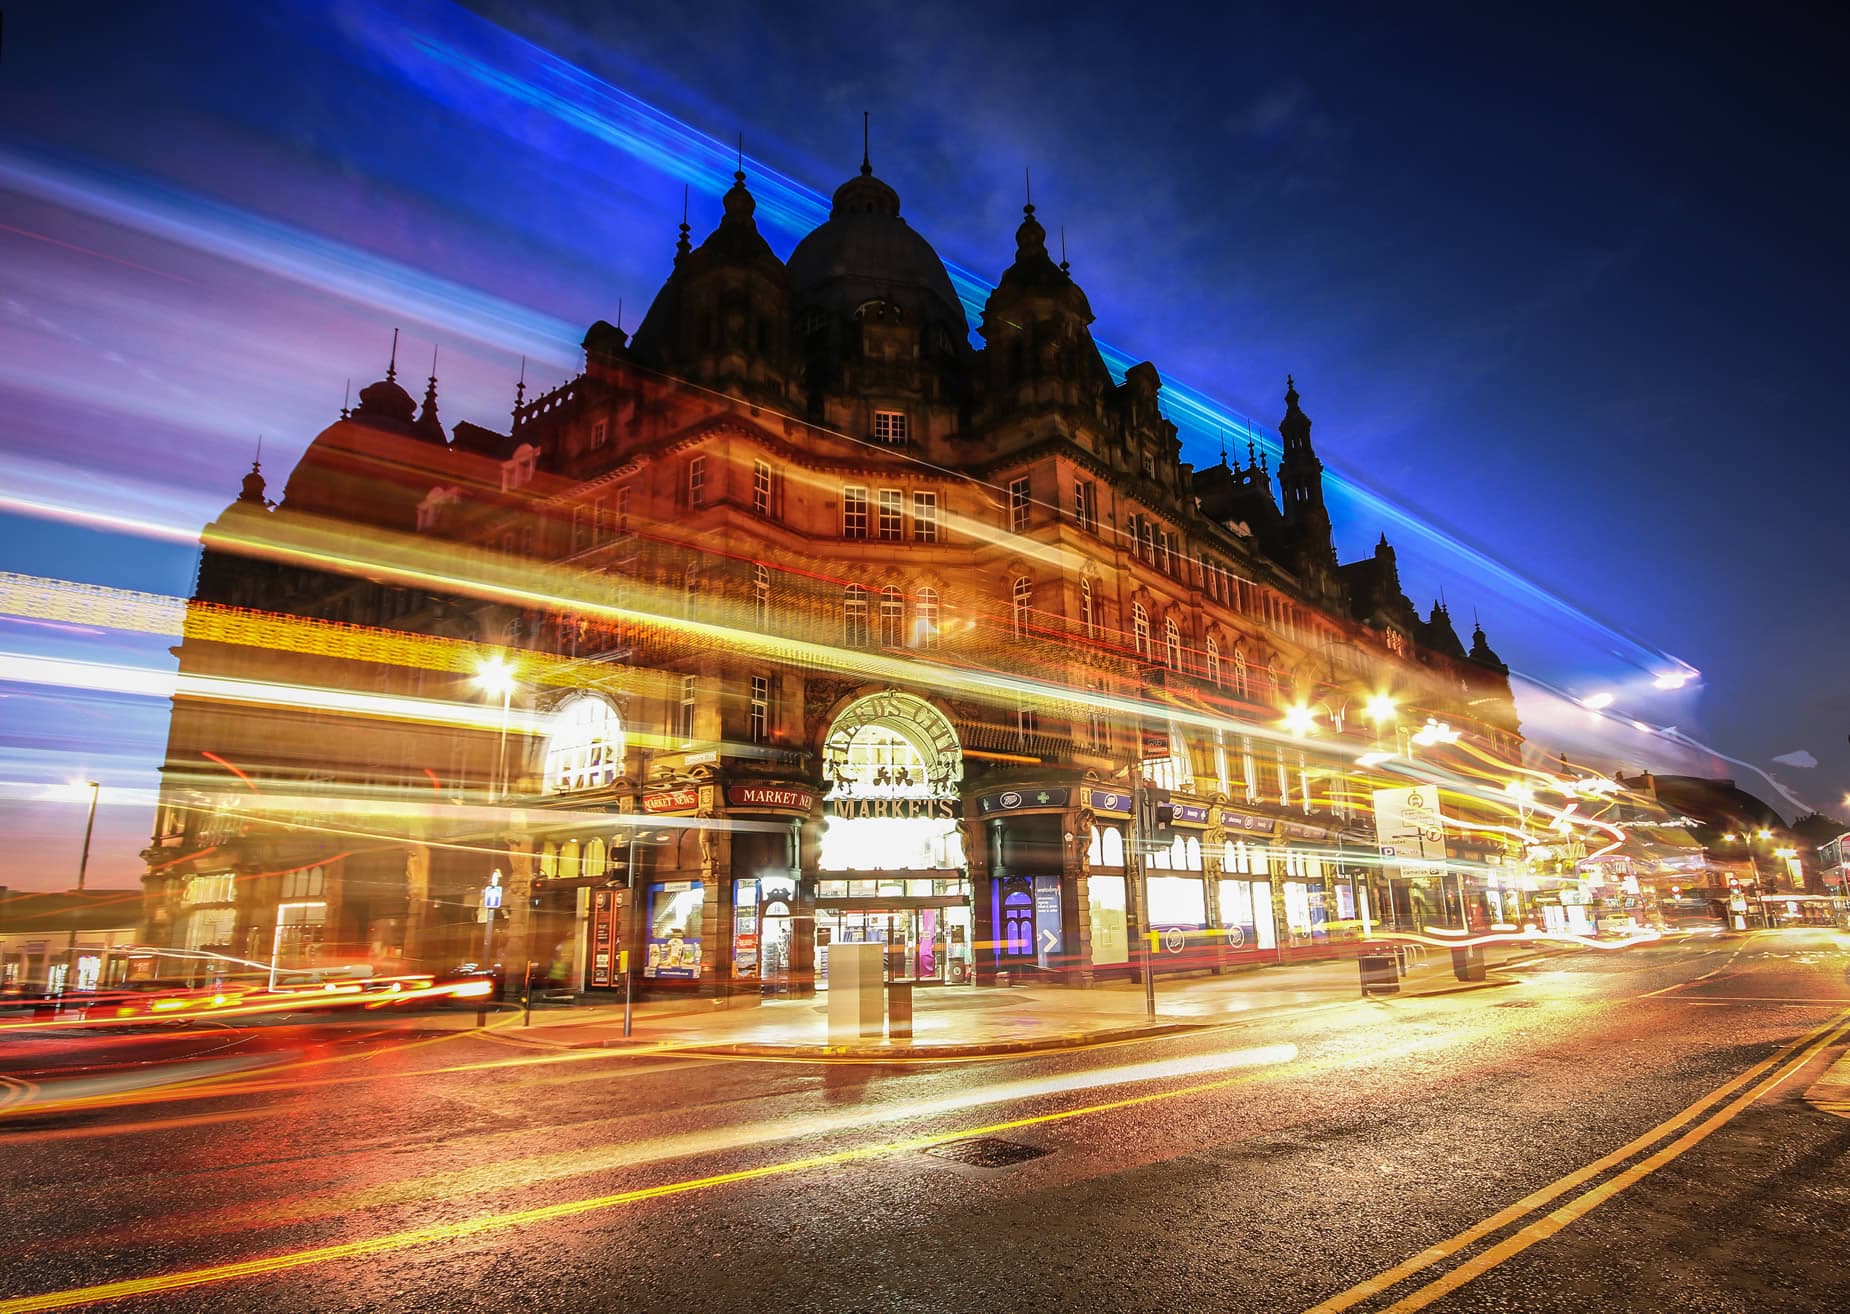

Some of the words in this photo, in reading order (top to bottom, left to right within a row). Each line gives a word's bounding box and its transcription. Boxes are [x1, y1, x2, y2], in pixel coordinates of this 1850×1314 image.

[827, 699, 902, 754] LEEDS
[912, 705, 961, 753] CITY
[644, 797, 672, 809] MARKET
[674, 794, 695, 806] NEWS
[743, 789, 798, 805] MARKET
[799, 796, 813, 810] NE
[833, 798, 954, 820] MARKETS
